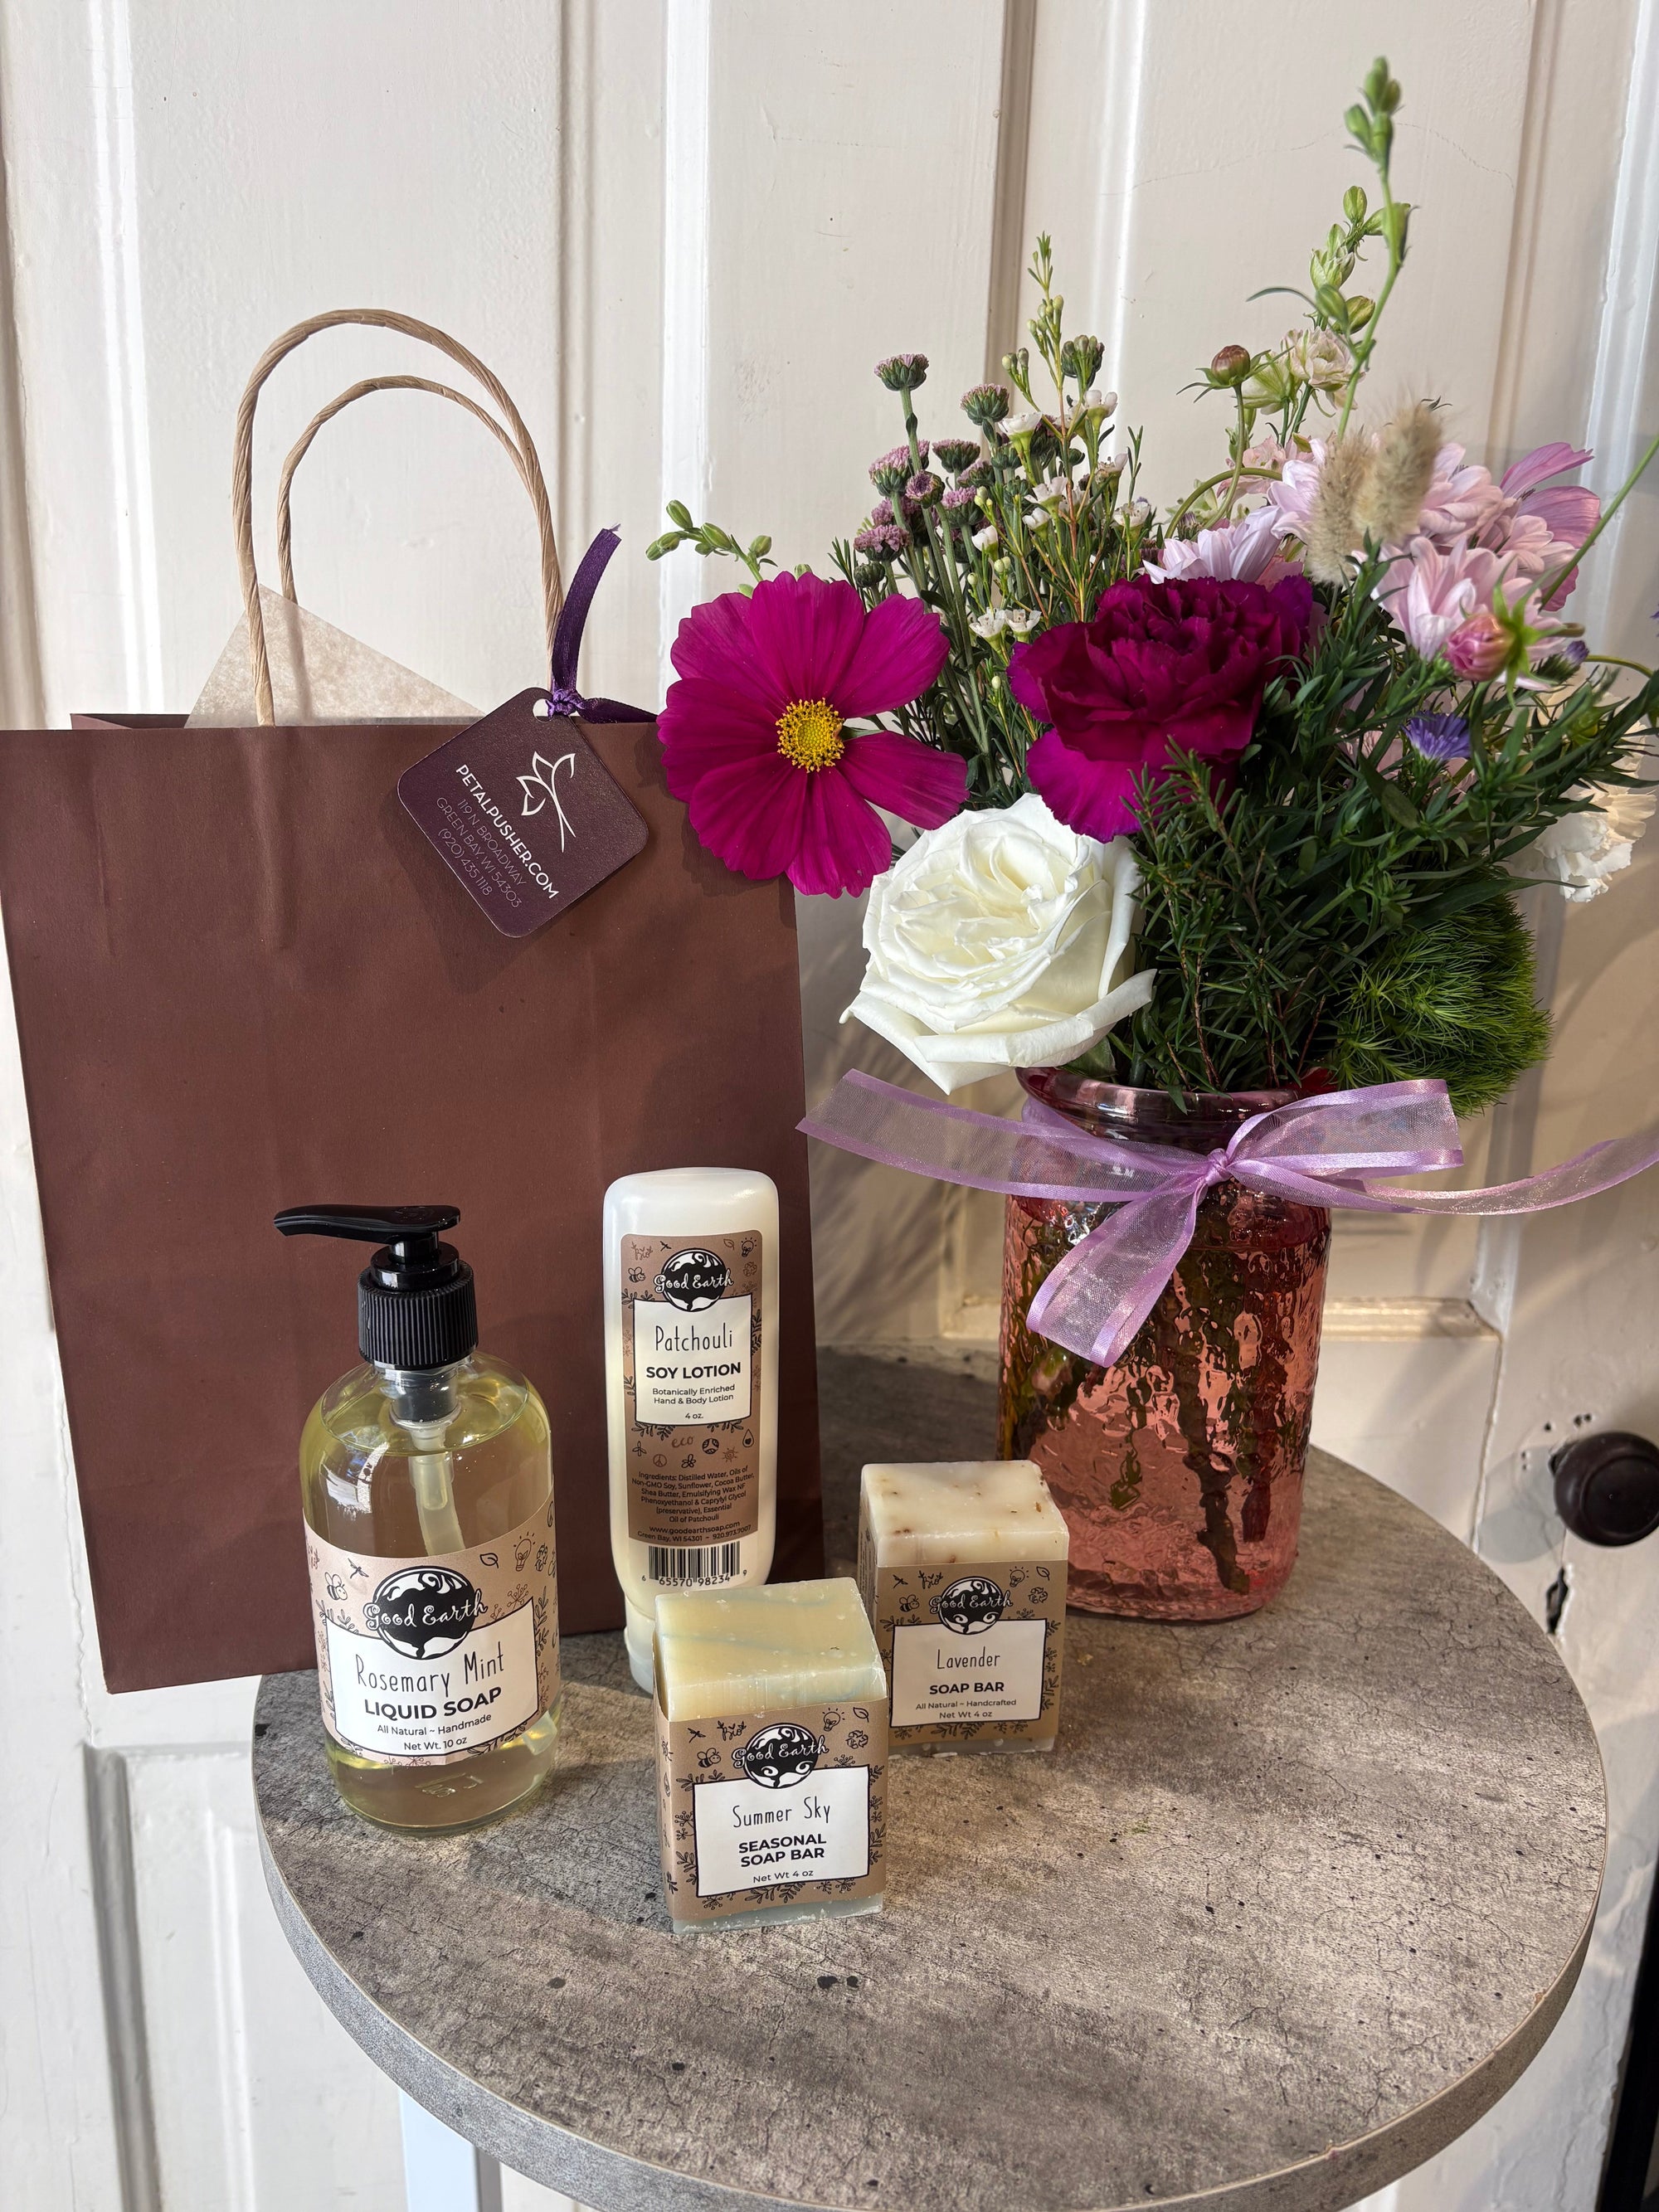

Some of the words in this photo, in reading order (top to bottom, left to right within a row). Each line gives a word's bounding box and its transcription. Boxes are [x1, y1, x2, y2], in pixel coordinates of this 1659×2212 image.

[456, 764, 559, 899] PETALPUSHER.COM
[436, 797, 468, 836] GREEN
[481, 856, 496, 873] WI
[491, 872, 522, 907] 54303
[458, 800, 472, 814] 119
[468, 814, 480, 828] N.
[476, 825, 527, 886] BROADWAY
[438, 828, 465, 858] (920)
[460, 858, 480, 878] 435
[475, 877, 493, 896] 1118
[653, 1273, 689, 1293] Good
[692, 1268, 735, 1289] Earth
[655, 1322, 732, 1351] Patchouli
[646, 1367, 679, 1379] SOY
[683, 1362, 742, 1379] LOTION
[652, 1388, 698, 1397] Botanically
[699, 1384, 735, 1395] Enriched
[686, 1397, 708, 1405] Body
[708, 1393, 734, 1403] Lotion
[671, 1436, 695, 1448] eco
[632, 1478, 662, 1488] Non-GMO
[664, 1482, 678, 1490] Soy,
[714, 1479, 734, 1487] Cocoa
[736, 1473, 755, 1482] Butter,
[639, 1471, 677, 1481] Ingredients:
[641, 1488, 657, 1496] Shea
[683, 1489, 721, 1498] Emulsifying
[641, 1496, 693, 1506] Phenoxyethanol
[701, 1496, 727, 1505] Caprylyl
[728, 1490, 747, 1500] Glycol
[656, 1507, 703, 1515] (preservative),
[703, 1503, 732, 1513] Essential
[688, 1513, 719, 1522] Patchouli
[637, 1530, 656, 1540] Green
[657, 1534, 671, 1543] Bay,
[713, 1524, 752, 1540] 920.973.7007
[649, 1521, 741, 1534] www.goodearthsoap.com
[659, 1577, 693, 1587] 65570
[698, 1574, 731, 1587] 98234
[362, 1602, 417, 1631] Good
[422, 1588, 489, 1625] Earth
[929, 1594, 966, 1614] Good
[969, 1590, 1014, 1608] Earth
[937, 1646, 1000, 1670] Lavender
[355, 1654, 450, 1698] Rosemary
[464, 1641, 504, 1685] Mint
[929, 1683, 970, 1695] SOAP
[974, 1681, 1005, 1693] BAR
[364, 1699, 437, 1721] LIQUID
[444, 1686, 502, 1717] SOAP
[377, 1724, 389, 1733] All
[391, 1726, 427, 1736] Natural
[438, 1714, 492, 1735] Handmade
[404, 1742, 421, 1751] Net
[423, 1741, 441, 1750] Wt.
[443, 1740, 453, 1748] 10
[455, 1737, 468, 1746] oz
[732, 1743, 775, 1768] Good
[779, 1735, 829, 1758] Earth
[732, 1805, 792, 1828] Summer
[804, 1796, 830, 1824] Sky
[739, 1833, 826, 1854] SEASONAL
[741, 1852, 786, 1868] SOAP
[791, 1847, 825, 1860] BAR
[753, 1874, 771, 1884] Net
